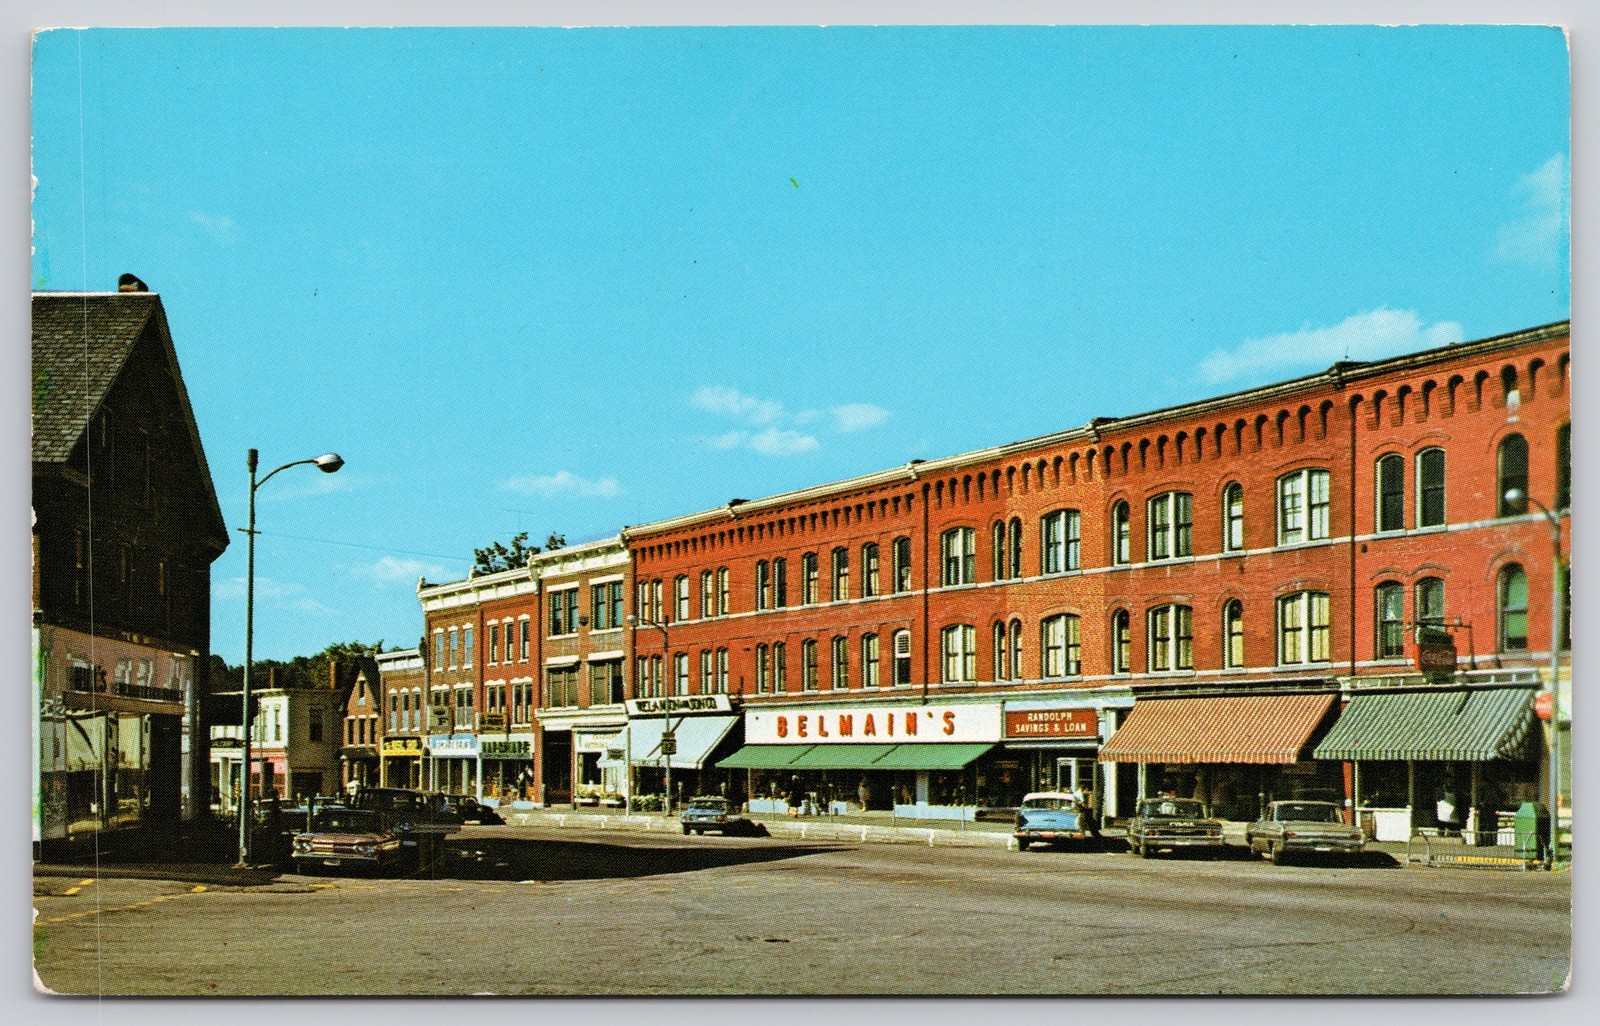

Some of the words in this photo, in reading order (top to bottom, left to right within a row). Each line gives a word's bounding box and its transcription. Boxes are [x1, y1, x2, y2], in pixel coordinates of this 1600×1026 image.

[1027, 711, 1073, 722] RANDOLPH
[777, 711, 956, 738] BELMAIN'S
[1015, 723, 1050, 733] SAVINGS
[1053, 723, 1061, 733] &
[1064, 722, 1087, 733] LOAN
